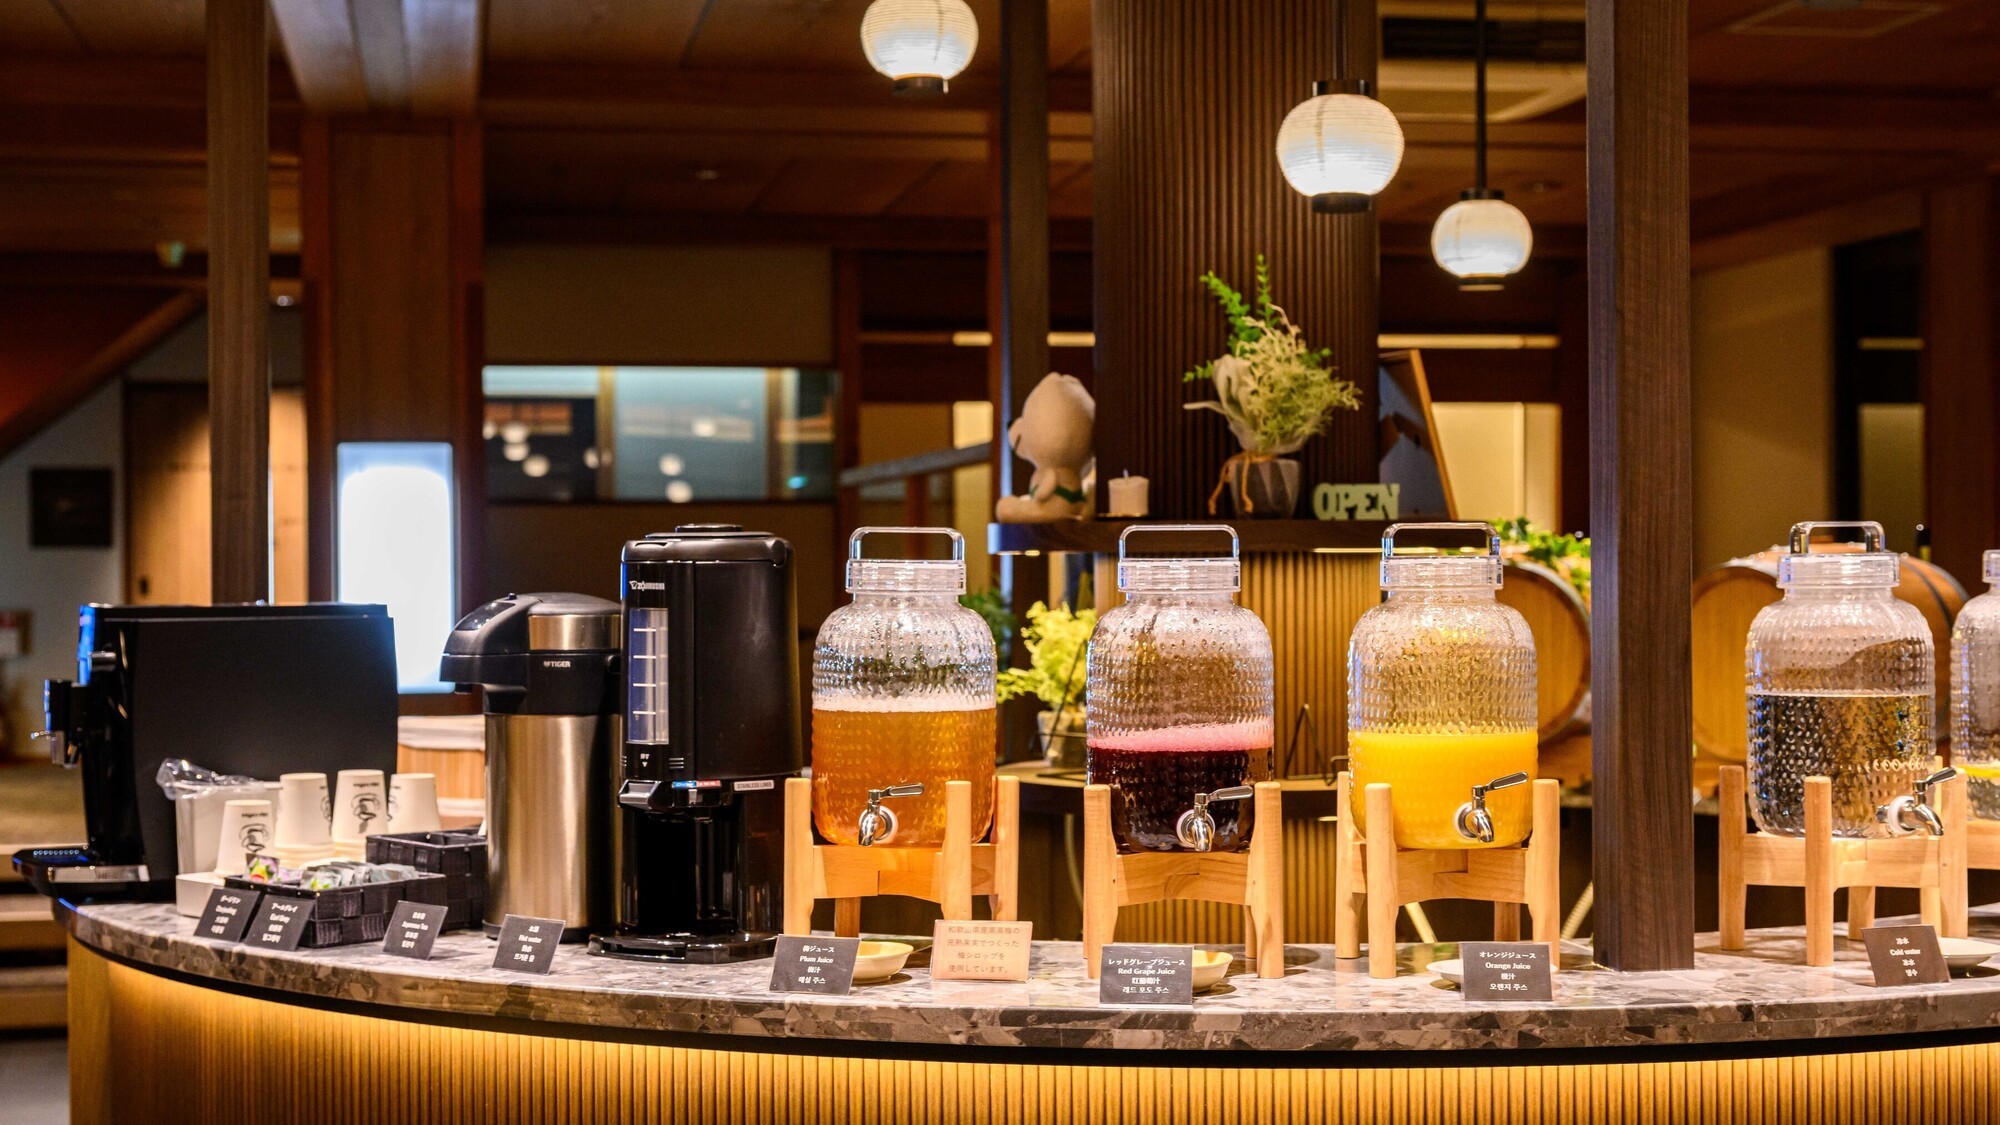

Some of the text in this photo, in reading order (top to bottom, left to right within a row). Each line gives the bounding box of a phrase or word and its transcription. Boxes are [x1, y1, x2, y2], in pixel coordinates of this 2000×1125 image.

[1314, 483, 1400, 520] OPEN
[518, 934, 528, 942] Hot
[947, 939, 1019, 947] 完熟果実でつくった
[802, 945, 835, 953] 梅ジュース
[957, 951, 1006, 960] 梅シロップを
[1479, 951, 1537, 959] オレンジジュース
[816, 956, 834, 964] Juice
[1108, 958, 1186, 966] レッドグレープジュース
[948, 964, 1008, 973] 使用しています。
[1485, 962, 1531, 970] Orange Juice
[1133, 968, 1156, 976] Grape
[1122, 986, 1170, 994] 레드 포도 주스
[1489, 983, 1511, 991] 오렌지
